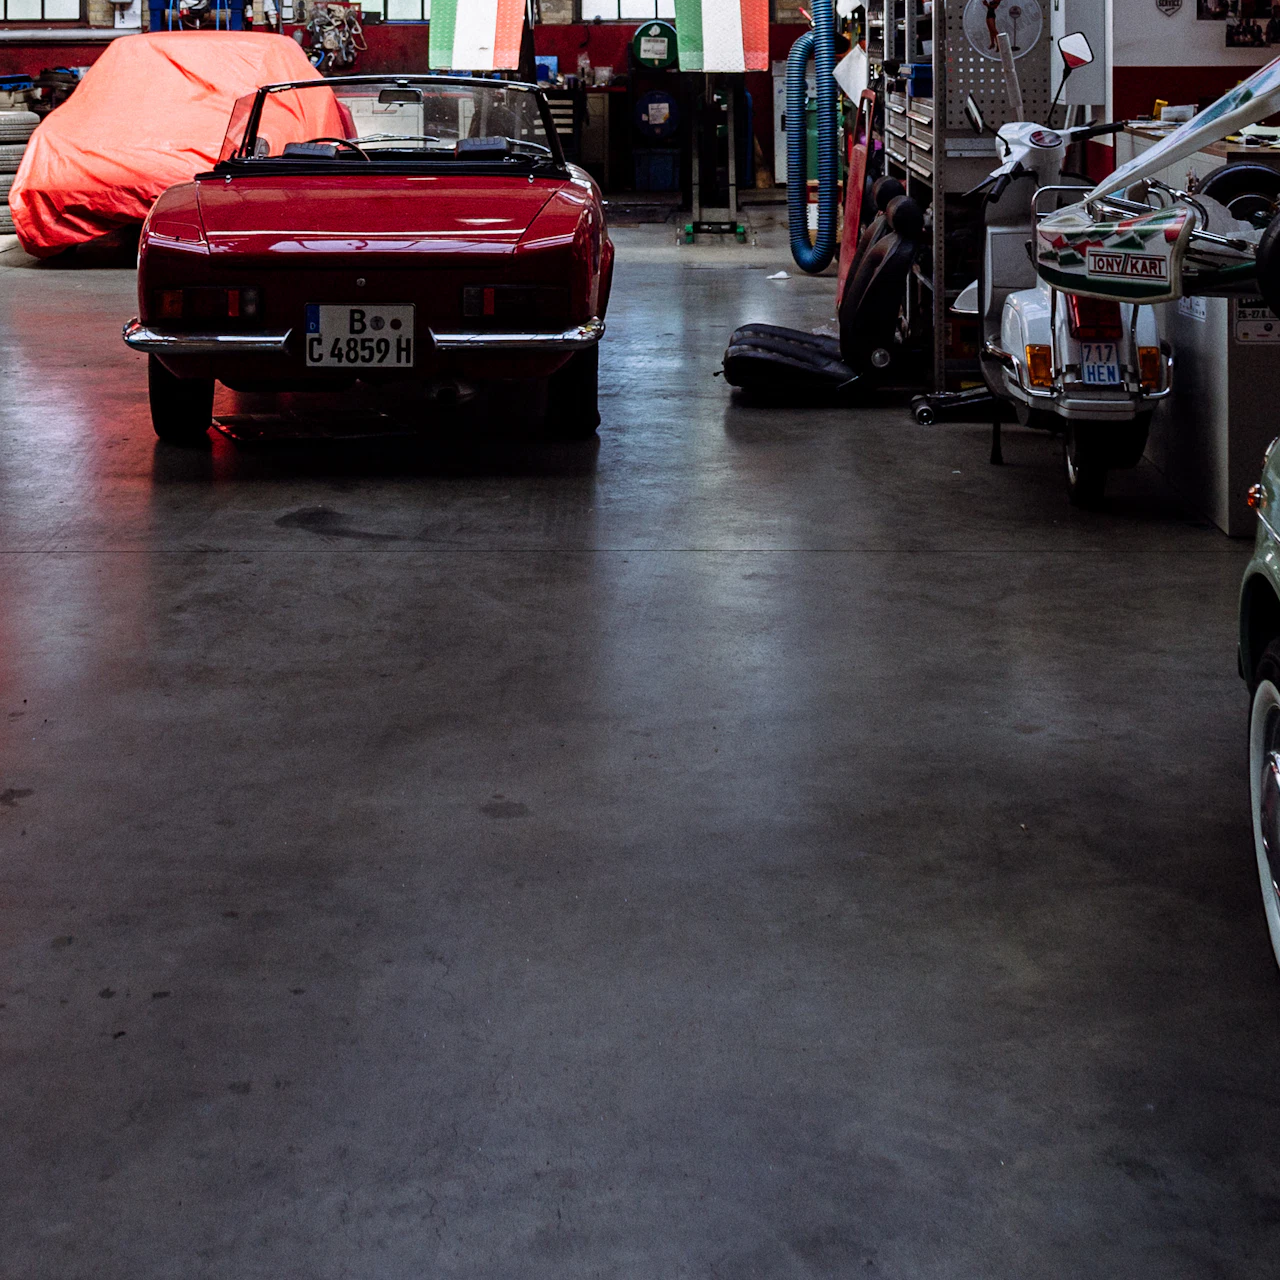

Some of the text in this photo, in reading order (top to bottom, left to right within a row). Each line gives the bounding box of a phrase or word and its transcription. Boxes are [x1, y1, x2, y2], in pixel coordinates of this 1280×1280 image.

[1090, 253, 1166, 276] TONY KART
[309, 322, 316, 330] D
[349, 309, 367, 334] B
[308, 337, 411, 363] C 4859 H
[1084, 344, 1113, 362] 717
[1087, 365, 1116, 382] HEN
